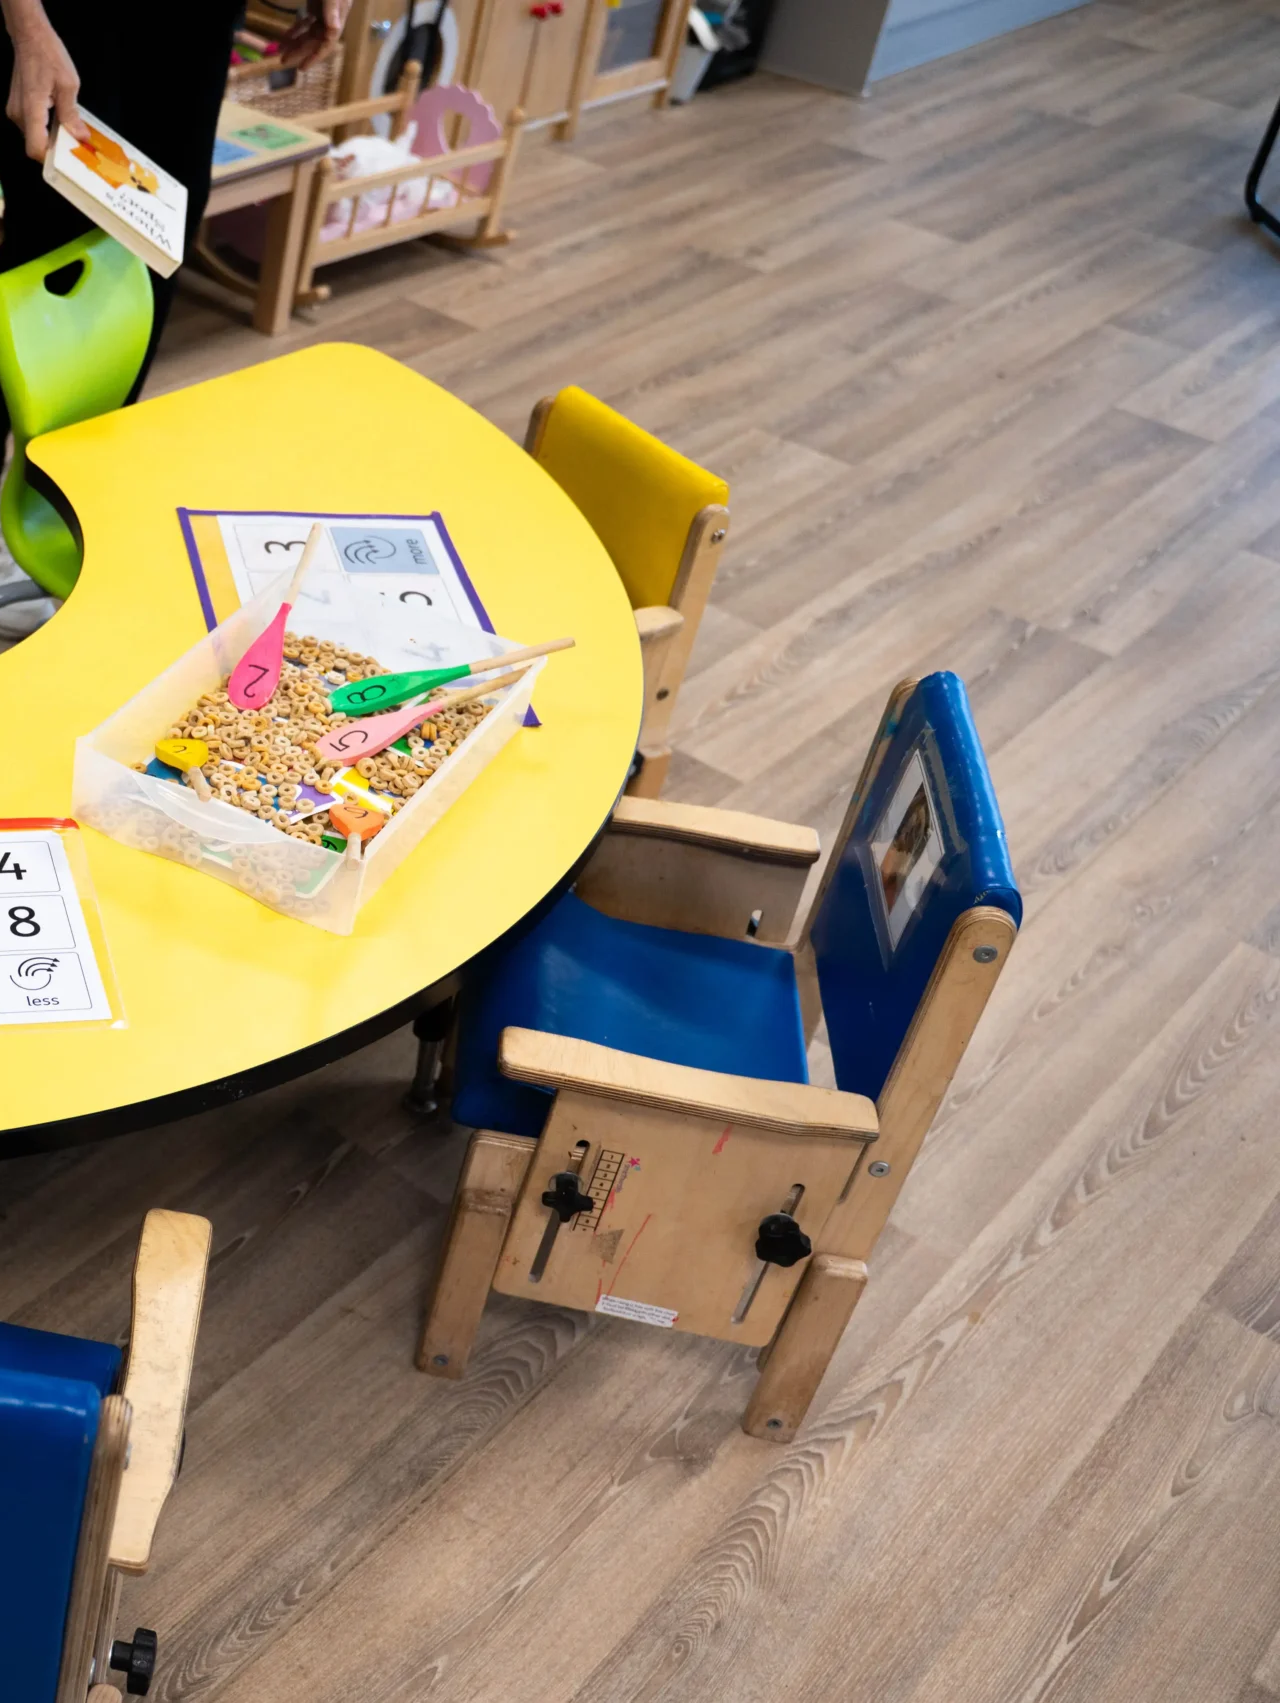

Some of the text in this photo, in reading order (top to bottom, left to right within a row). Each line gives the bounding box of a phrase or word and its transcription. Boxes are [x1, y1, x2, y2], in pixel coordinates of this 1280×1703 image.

[405, 538, 427, 565] more
[243, 664, 270, 698] 2
[347, 684, 387, 705] 8
[329, 729, 369, 752] 5
[8, 905, 41, 938] 8
[26, 995, 60, 1007] less
